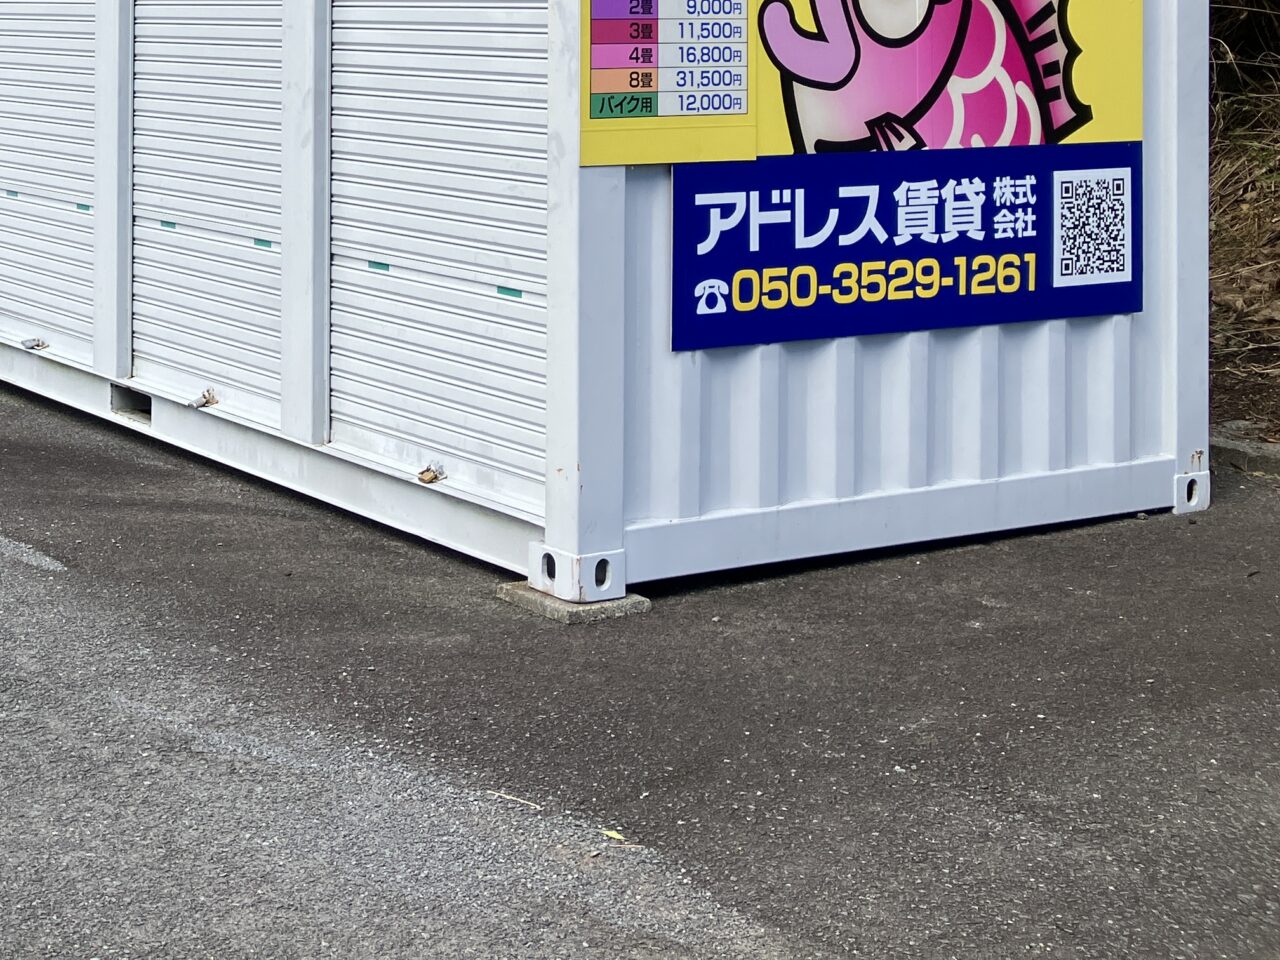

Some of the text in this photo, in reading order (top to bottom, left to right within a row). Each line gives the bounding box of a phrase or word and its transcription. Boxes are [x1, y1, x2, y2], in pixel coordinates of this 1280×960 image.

[629, 22, 653, 40] 3畳
[678, 22, 742, 40] 11,500円
[628, 46, 653, 64] 4畳
[678, 46, 742, 64] 16,800円
[629, 71, 653, 88] 8畳
[676, 70, 742, 88] 31,500円
[599, 95, 653, 114] バイク用
[678, 93, 742, 112] 12,000円
[693, 177, 987, 256] アドレス賃貸
[731, 252, 1037, 312] 050-3529-1261
